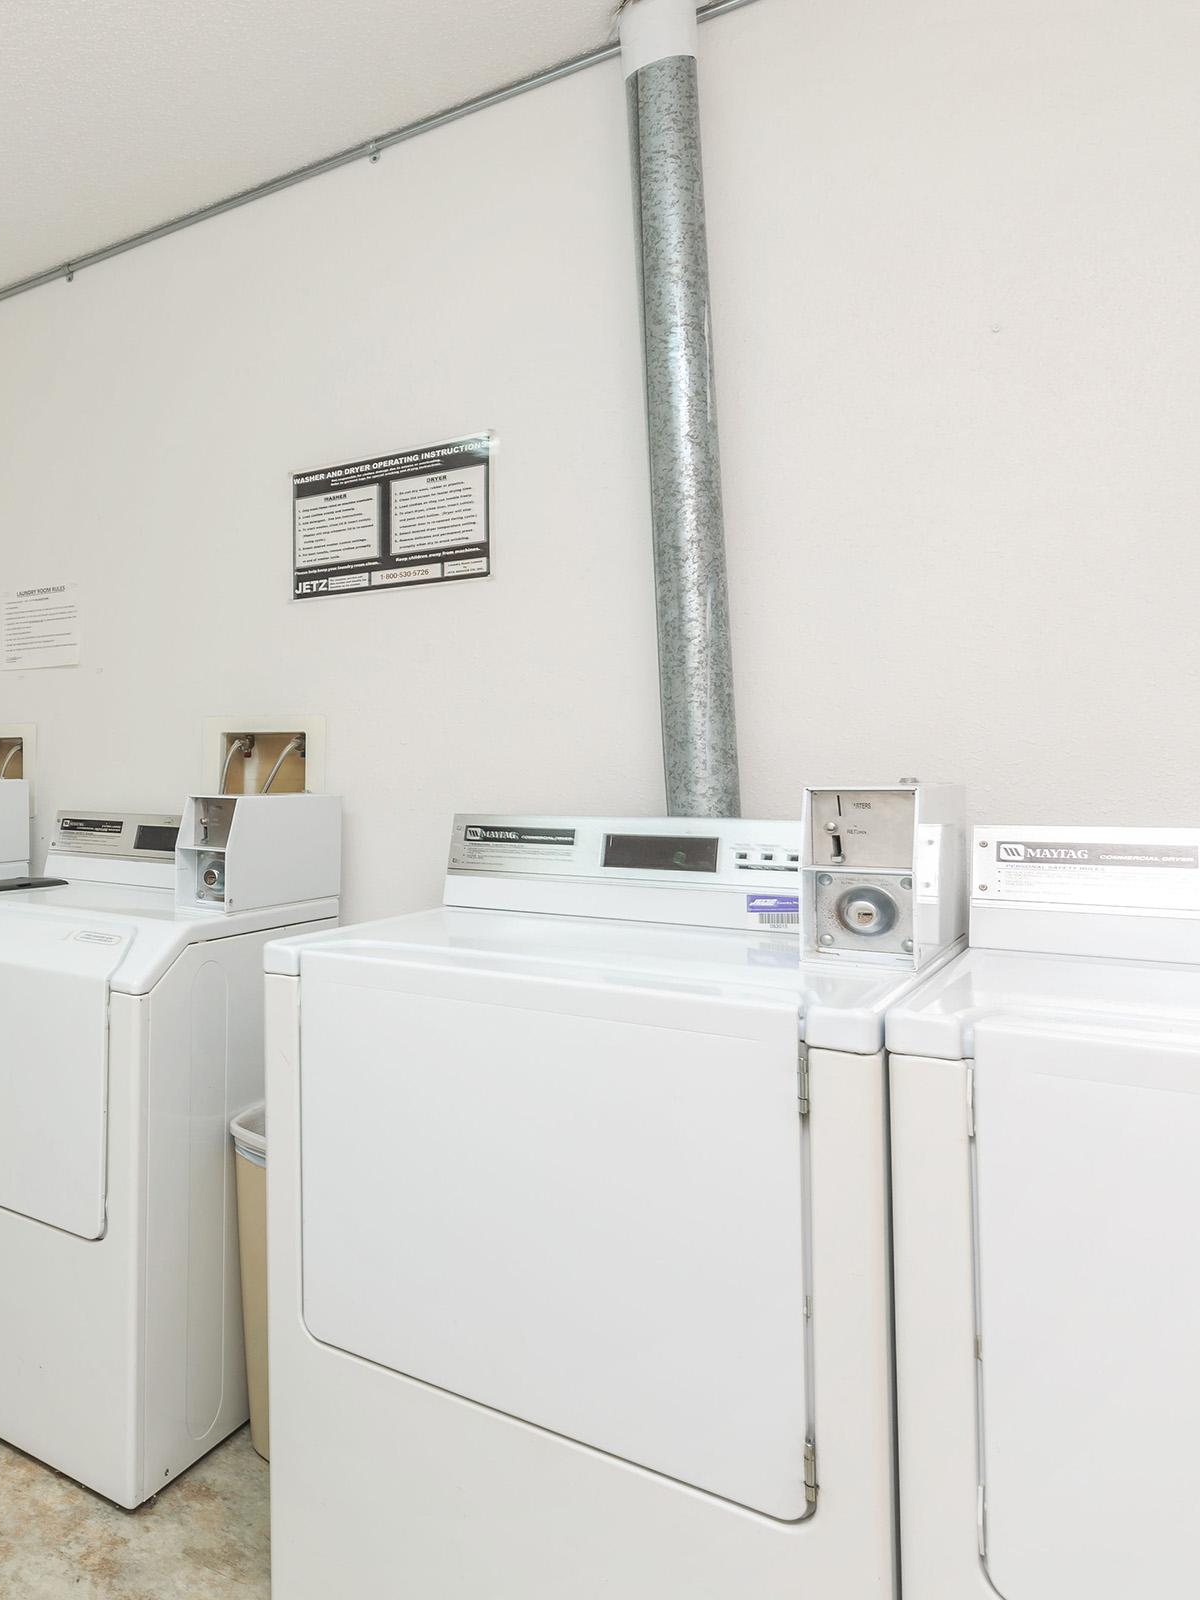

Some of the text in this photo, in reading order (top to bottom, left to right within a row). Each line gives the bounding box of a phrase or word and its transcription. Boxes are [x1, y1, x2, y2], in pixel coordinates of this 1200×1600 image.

[293, 473, 325, 485] WASHER
[326, 470, 342, 479] AND
[344, 464, 370, 475] DRYER
[372, 454, 419, 469] OPERATING
[294, 579, 328, 594] JETZ
[480, 830, 520, 840] MAYTAG
[1026, 848, 1089, 860] MAYTAG
[1099, 854, 1160, 862] COMMERCIAL
